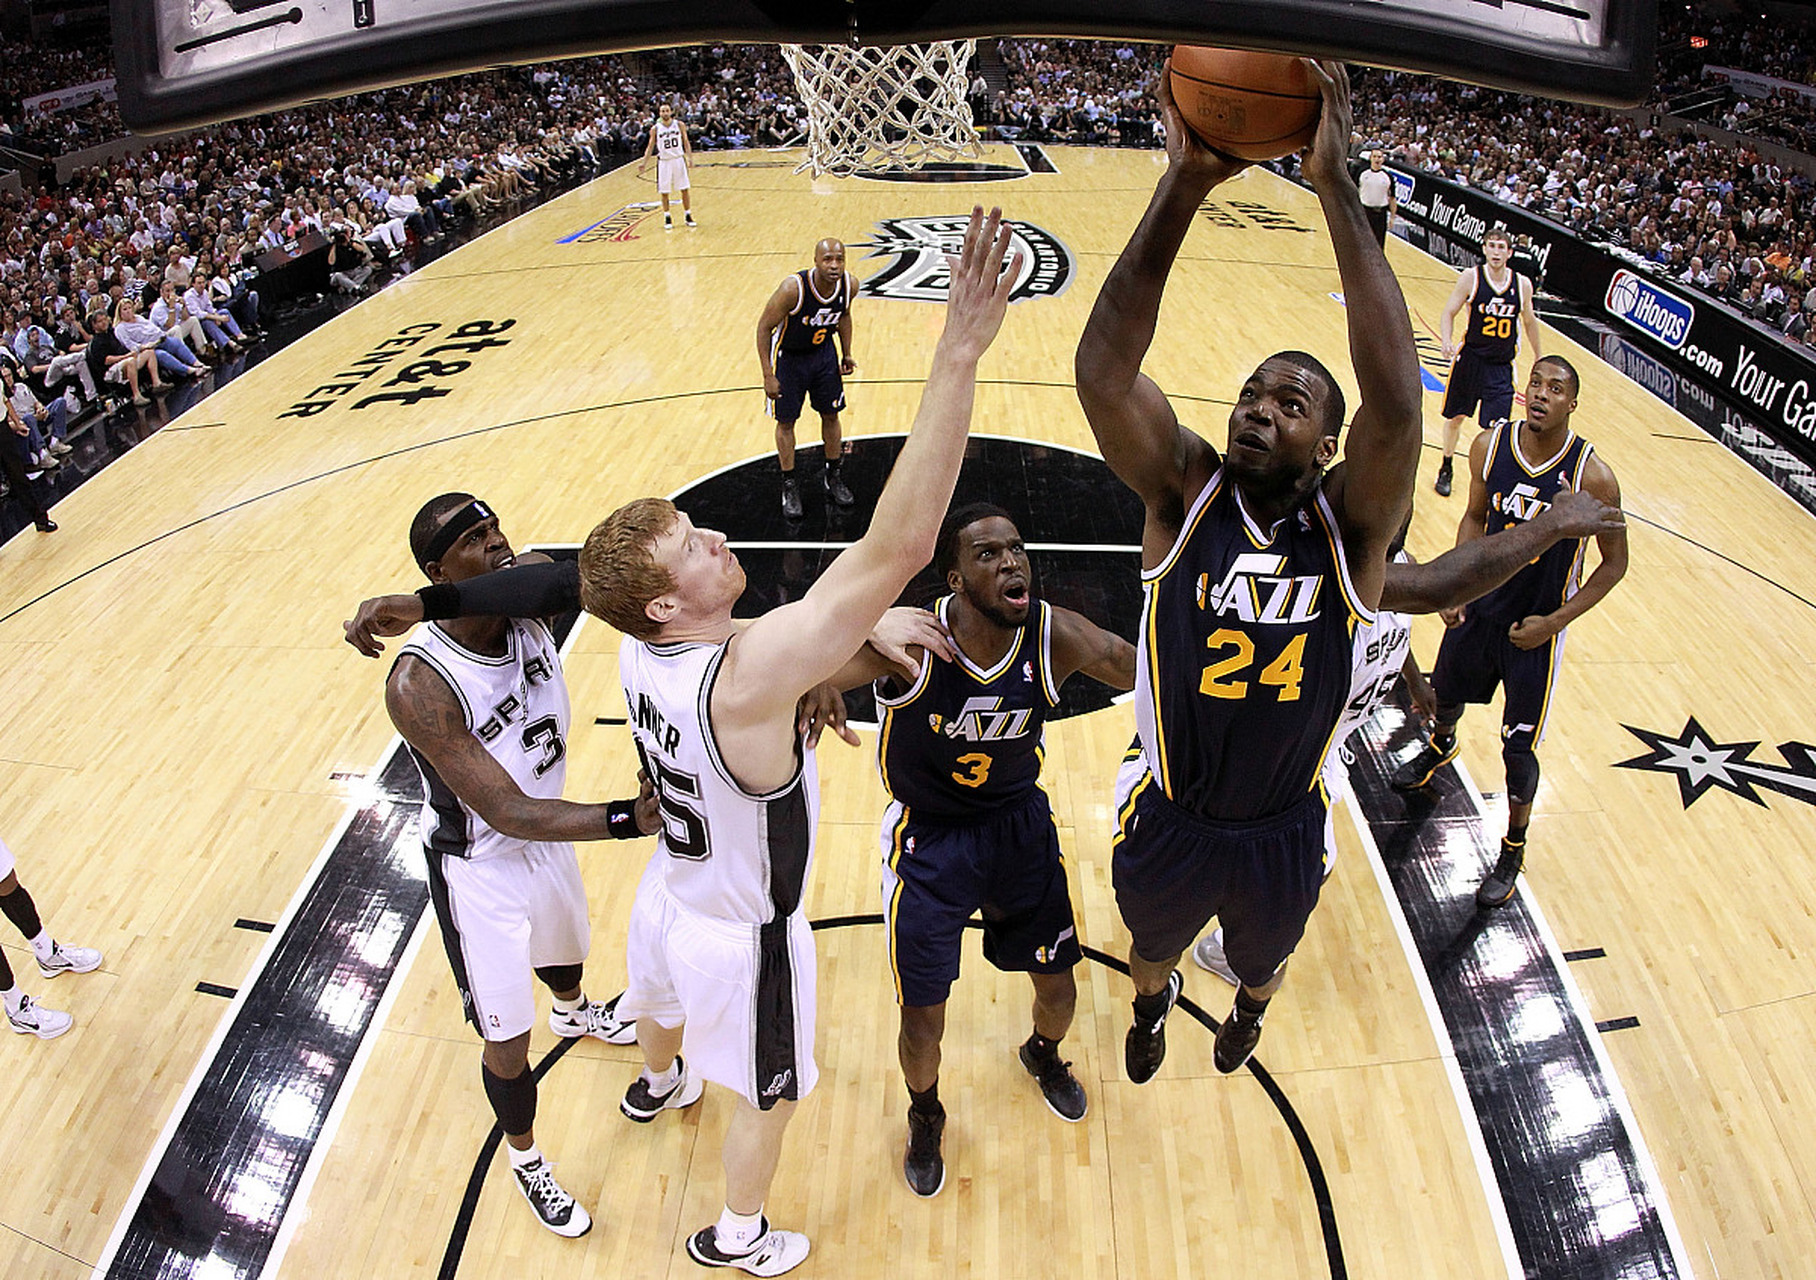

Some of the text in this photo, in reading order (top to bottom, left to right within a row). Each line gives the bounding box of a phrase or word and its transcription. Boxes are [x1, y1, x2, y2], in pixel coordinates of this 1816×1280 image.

[664, 138, 679, 149] 20
[1430, 193, 1454, 227] Your
[1028, 243, 1060, 291] ANTONIO
[1482, 316, 1512, 339] 20
[1485, 297, 1516, 318] JAZZ
[812, 328, 827, 345] 6
[275, 322, 443, 420] CENTER
[349, 318, 517, 411] at&t
[1634, 290, 1816, 442] iHoops .com Your Ga
[1210, 553, 1324, 624] JAZZ
[1199, 628, 1309, 702] 24
[944, 696, 1033, 742] JAZZ
[520, 713, 567, 780] 3
[951, 752, 993, 788] 3
